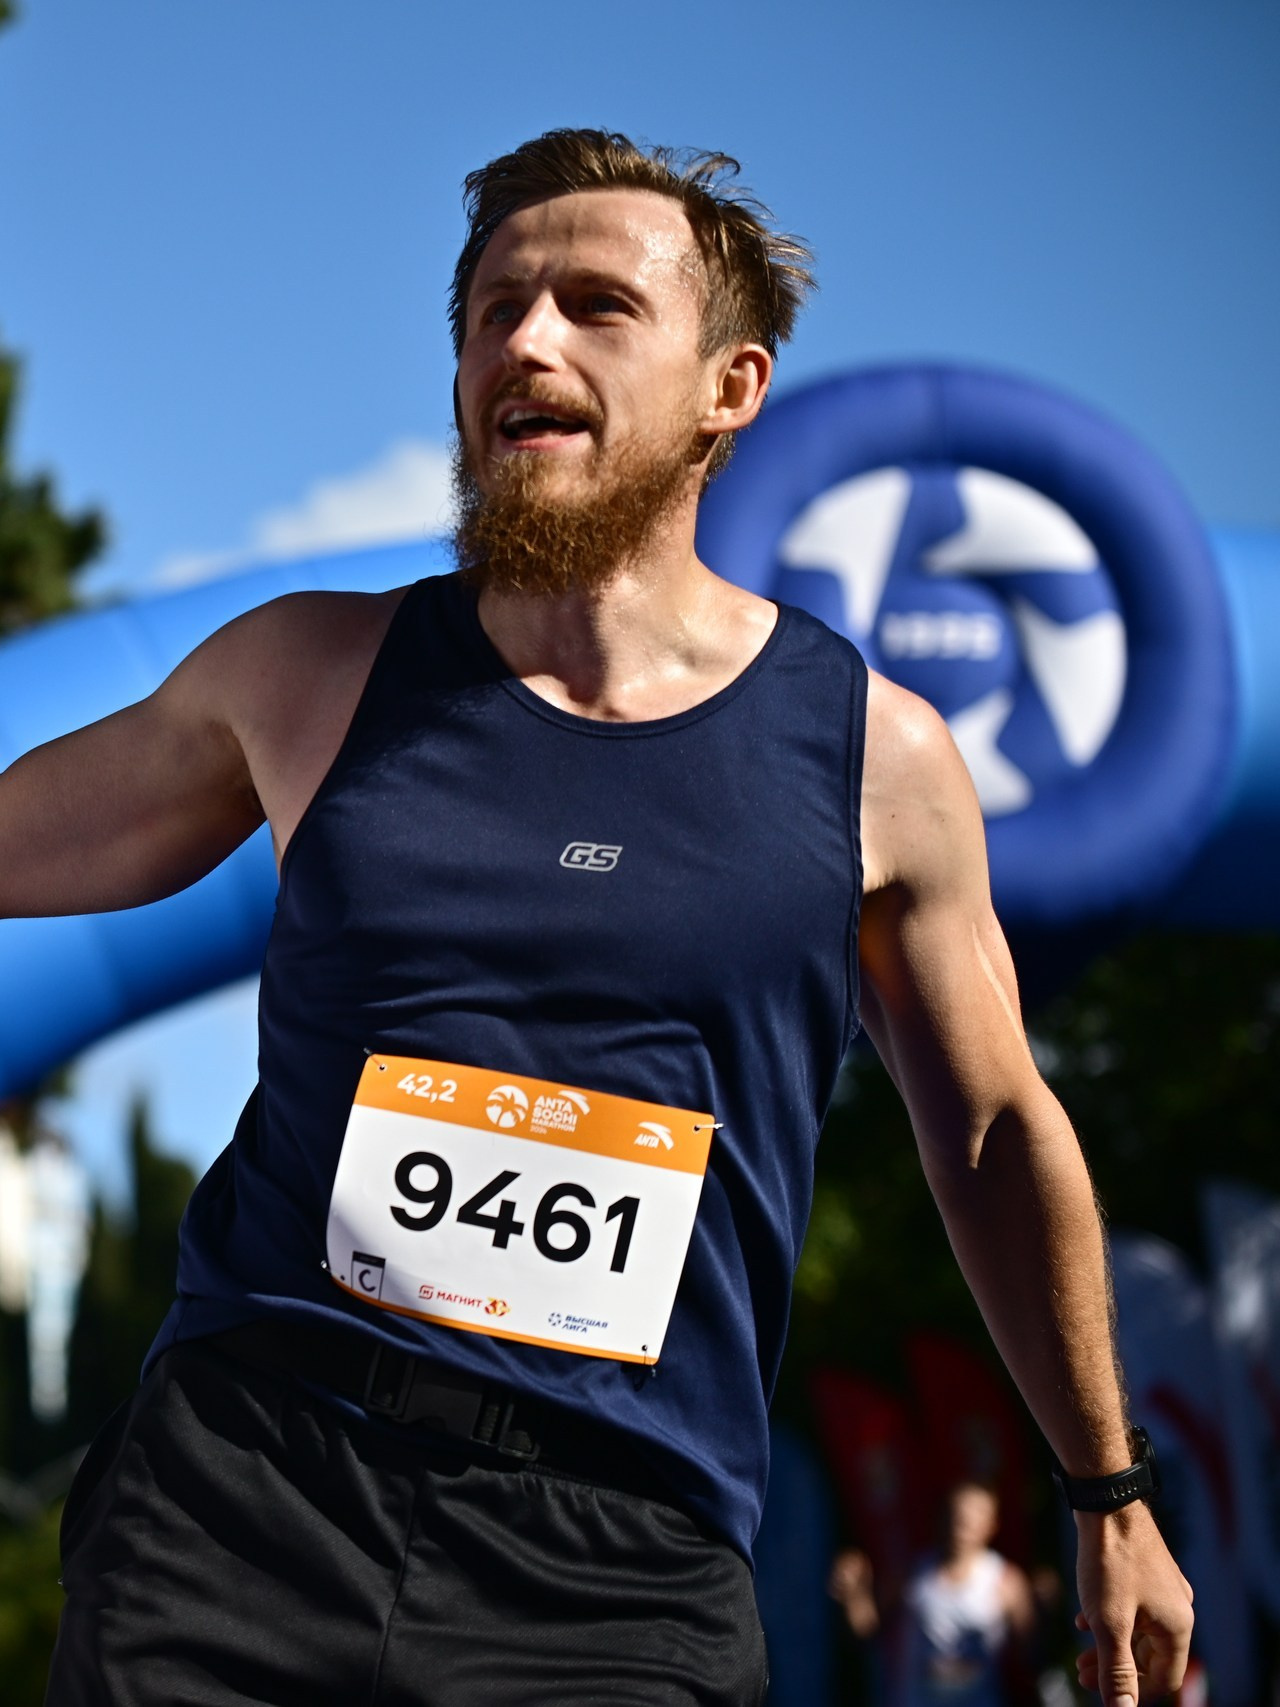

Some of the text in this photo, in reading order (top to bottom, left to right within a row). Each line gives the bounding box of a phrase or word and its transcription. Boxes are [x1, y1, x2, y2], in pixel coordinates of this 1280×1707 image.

[559, 841, 623, 872] GS
[397, 1073, 458, 1103] 42,2
[535, 1095, 573, 1113] ANTA
[532, 1106, 578, 1125] SOCHI
[531, 1118, 576, 1132] MARATHON
[634, 1133, 660, 1149] ANTA
[390, 1150, 641, 1274] 9461
[436, 1291, 482, 1308] МАГНИТ
[561, 1323, 588, 1333] ЛИГА
[565, 1315, 608, 1328] ВЫСШАЯ
